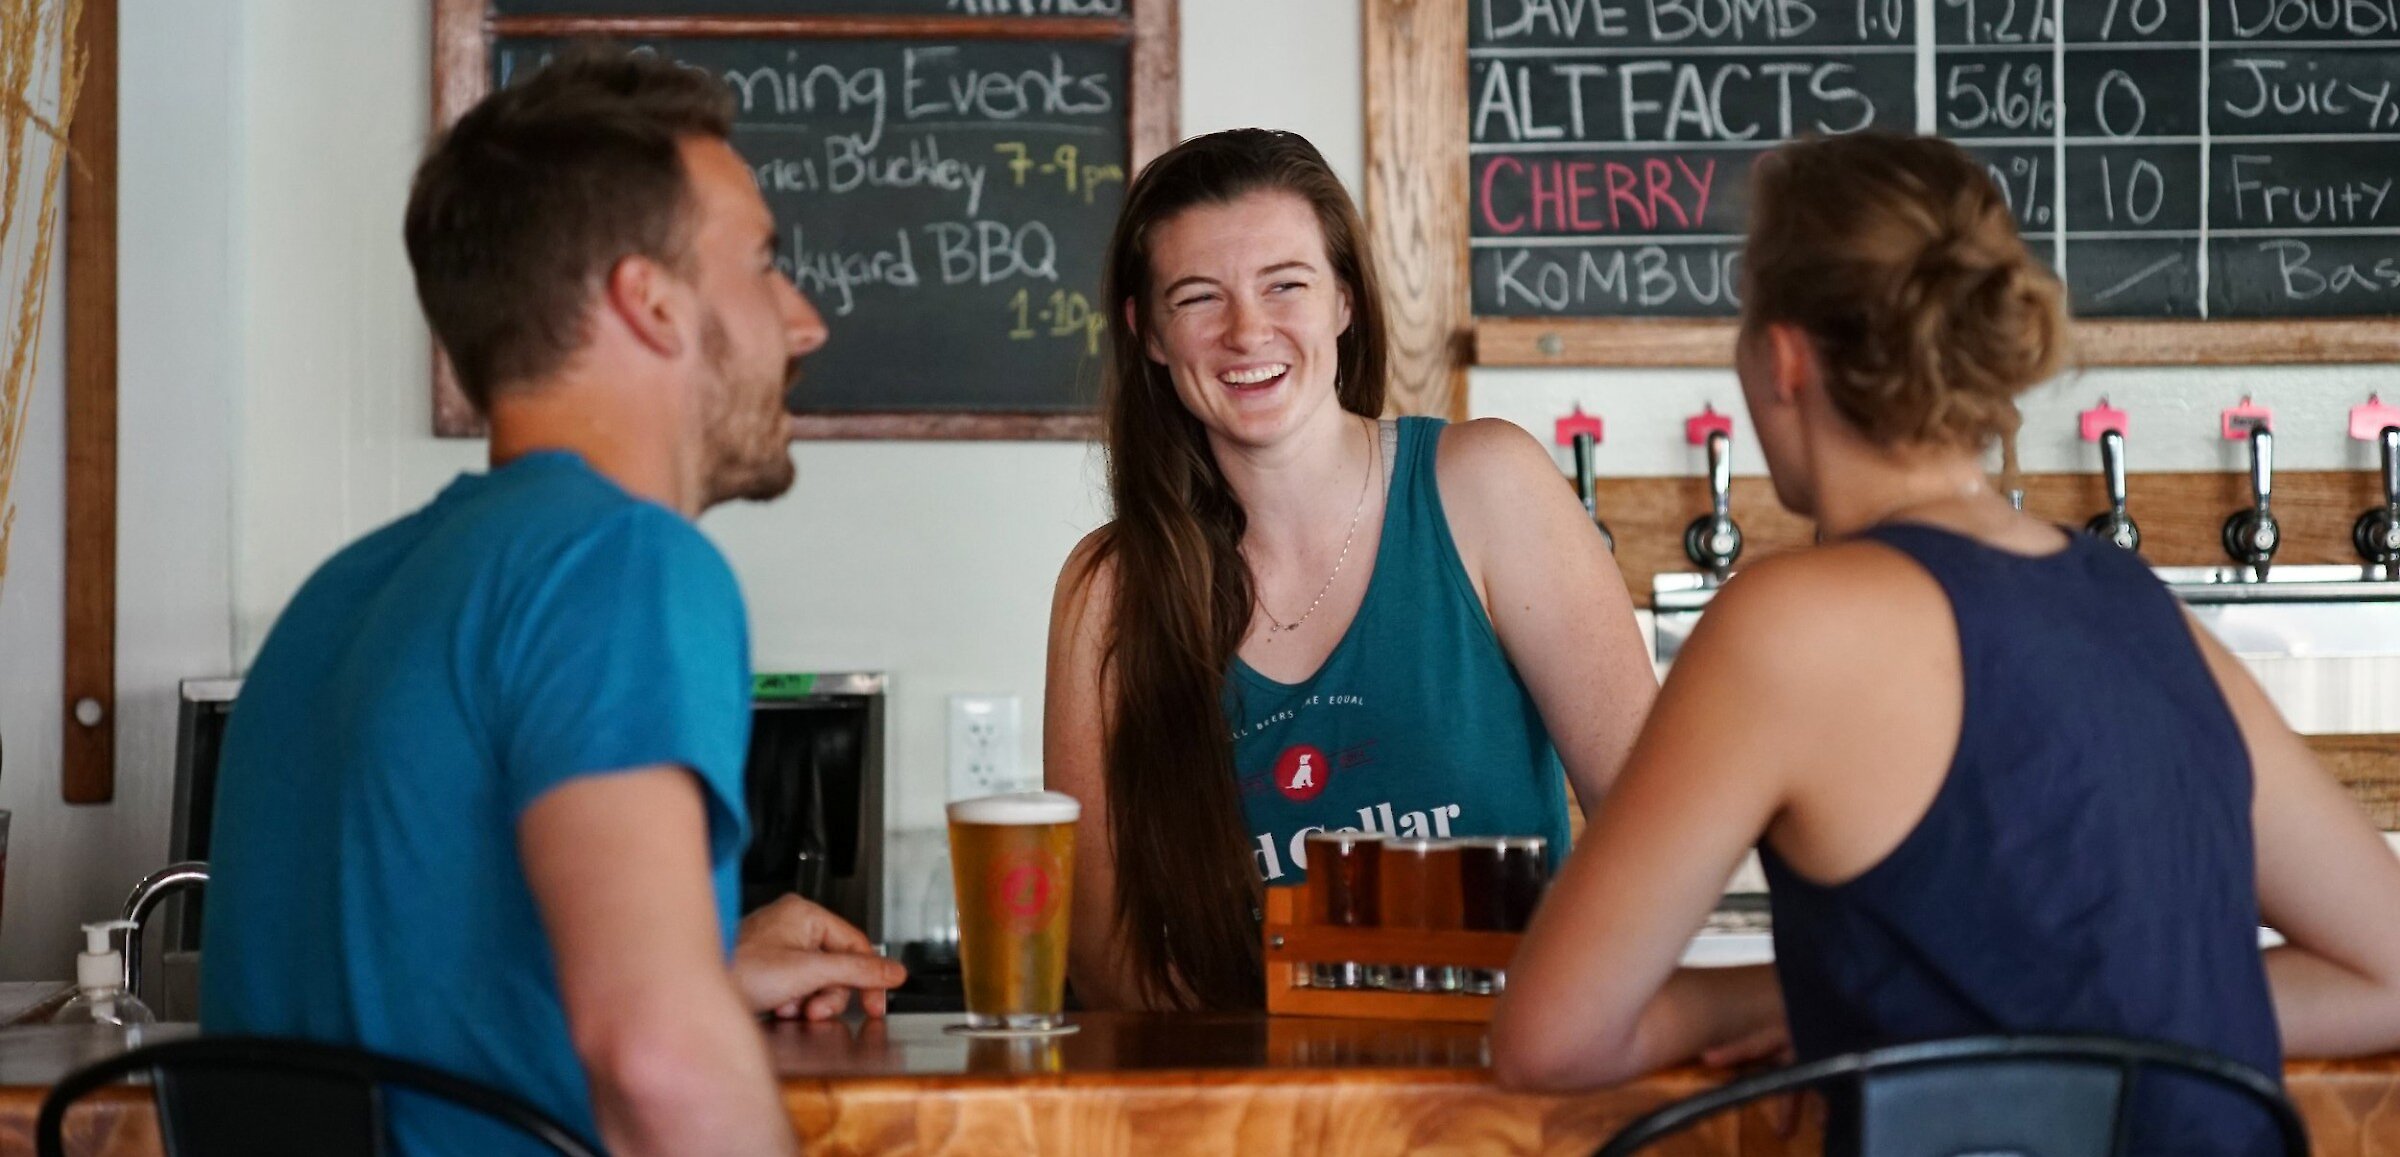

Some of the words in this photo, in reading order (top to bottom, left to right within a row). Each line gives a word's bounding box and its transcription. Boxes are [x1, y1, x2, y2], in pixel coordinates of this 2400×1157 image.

[903, 46, 1113, 119] Events
[1474, 60, 1607, 140] ALT
[1617, 61, 1876, 140] FACTS
[1947, 62, 2057, 131] 5.6%
[824, 133, 986, 218] Buckley
[1480, 155, 1717, 234] CHERRY
[2101, 155, 2165, 226] 10
[923, 220, 1059, 286] BBQ
[1256, 710, 1294, 731] BEERS
[1329, 695, 1364, 707] EQUAL
[1289, 802, 1461, 870] Cllar
